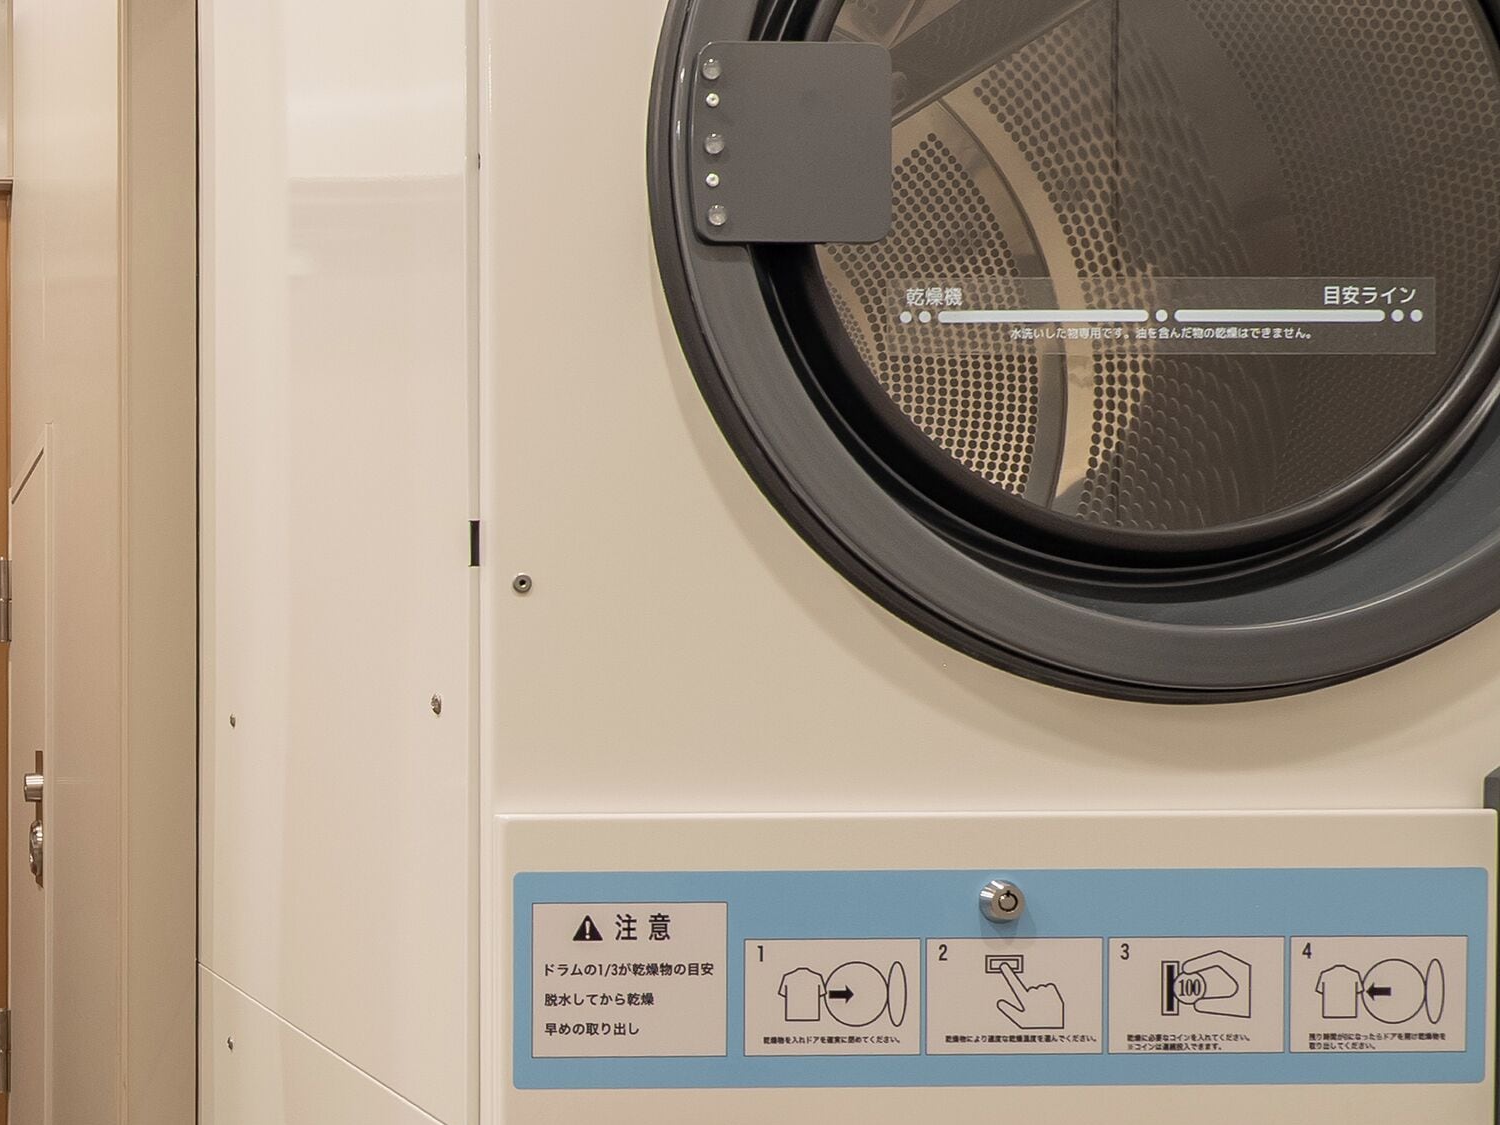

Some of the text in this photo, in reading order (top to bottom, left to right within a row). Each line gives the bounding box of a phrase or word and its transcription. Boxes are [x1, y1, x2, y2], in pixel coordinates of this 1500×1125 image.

[906, 286, 1416, 307] 乾燥機 目安ライン
[1010, 327, 1312, 340] 水洗いした物専用です。油を含んだ物の乾燥はできません。
[615, 913, 671, 941] 注意
[757, 945, 764, 962] 1
[938, 944, 948, 961] 2
[1120, 943, 1130, 960] 3
[1302, 942, 1312, 959] 4
[544, 962, 714, 977] ドラムの1/3が乾燥物の目安
[1178, 979, 1201, 997] 100
[544, 993, 654, 1006] 脱水してから乾燥
[544, 1023, 640, 1036] 早めの取り出し
